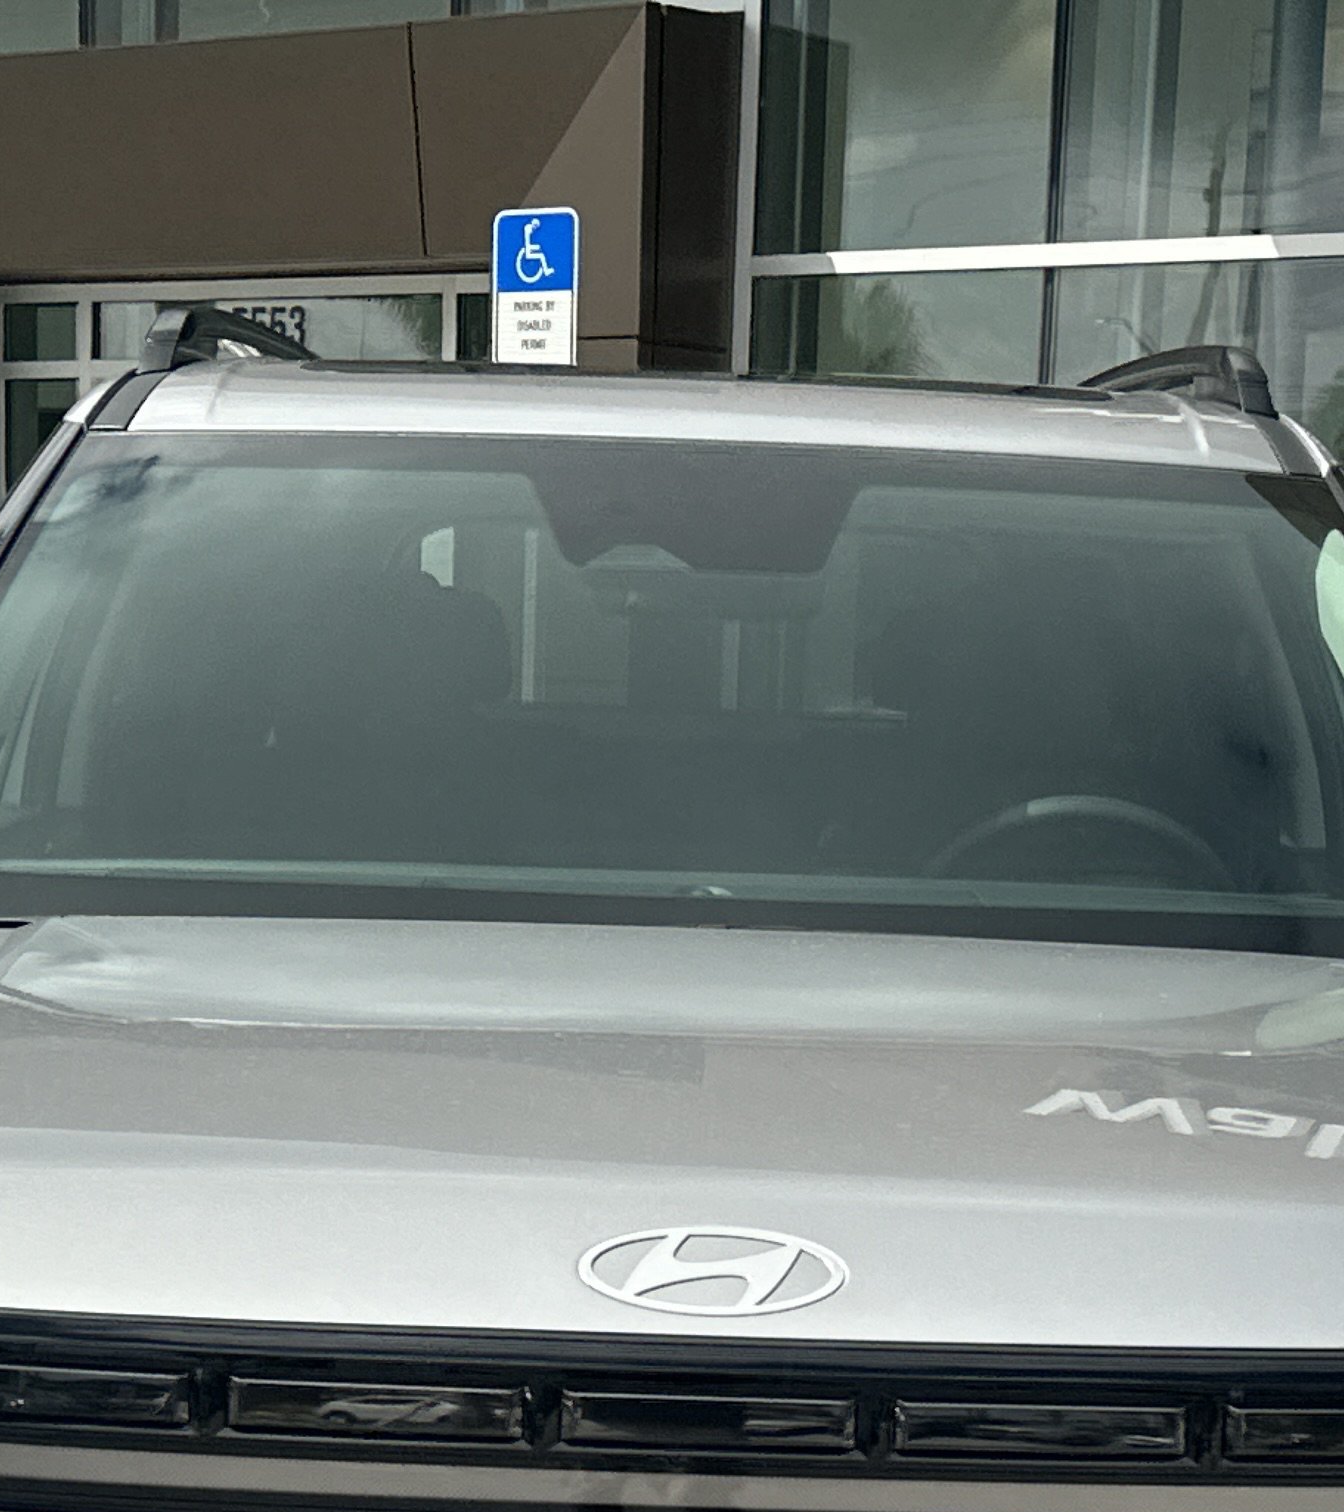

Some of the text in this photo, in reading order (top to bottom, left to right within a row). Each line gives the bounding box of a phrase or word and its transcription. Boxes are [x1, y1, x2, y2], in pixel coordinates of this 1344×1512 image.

[513, 300, 555, 312] PARKING BY
[232, 306, 306, 349] 53
[517, 319, 552, 331] DISABLED
